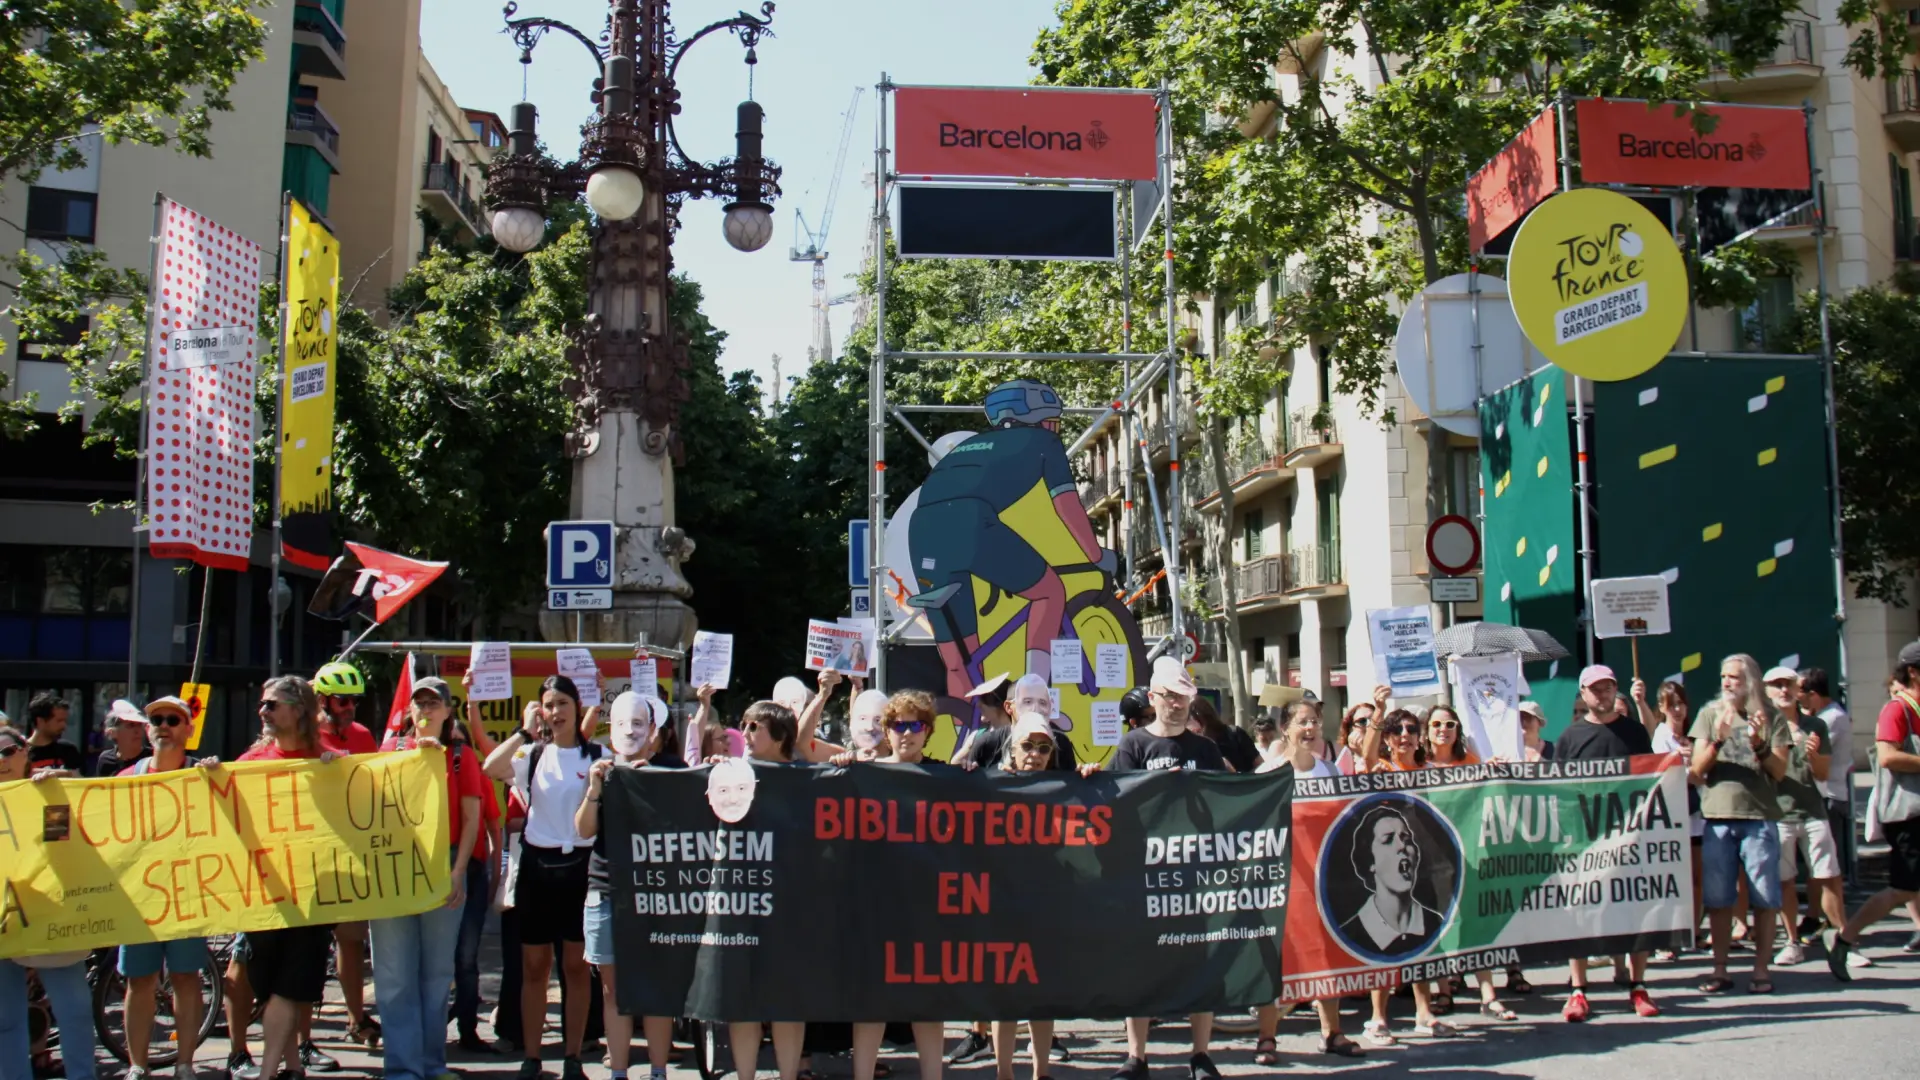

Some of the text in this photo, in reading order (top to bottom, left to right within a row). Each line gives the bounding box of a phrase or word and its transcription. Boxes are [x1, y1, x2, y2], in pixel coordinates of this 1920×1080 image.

[939, 122, 1082, 151] Barcelona
[1618, 133, 1743, 162] Barcelona
[1562, 300, 1642, 339] BARCELONE 2026
[1563, 303, 1599, 325] GRAND
[561, 529, 600, 579] P
[1293, 758, 1625, 797] REM ELS SERVEIS SOCIALS DE LA CIUTAT
[77, 769, 241, 847] CUIDEM
[265, 770, 315, 834] EL
[346, 762, 425, 831] OAC
[814, 796, 1113, 846] BIBLIOTEQUES
[1478, 783, 1683, 849] AVUI, VAGA.
[370, 833, 392, 849] EN
[631, 828, 774, 864] DEFENSEM
[1478, 839, 1682, 881] CONDICIONS DIGNES PER
[142, 844, 298, 926] SERVEI
[633, 867, 773, 887] LES NOSTRES
[938, 872, 990, 915] EN
[1145, 861, 1286, 889] LES NOSTRES
[75, 903, 89, 912] de
[1146, 884, 1287, 918] BIBLIOTEQUES
[1478, 886, 1515, 918] UNA
[1610, 873, 1680, 904] DIGNA
[47, 918, 116, 941] Barcelona
[884, 941, 1039, 985] LLUITA
[1282, 947, 1520, 1001] AJUNTAMENT DE BARCELONA
